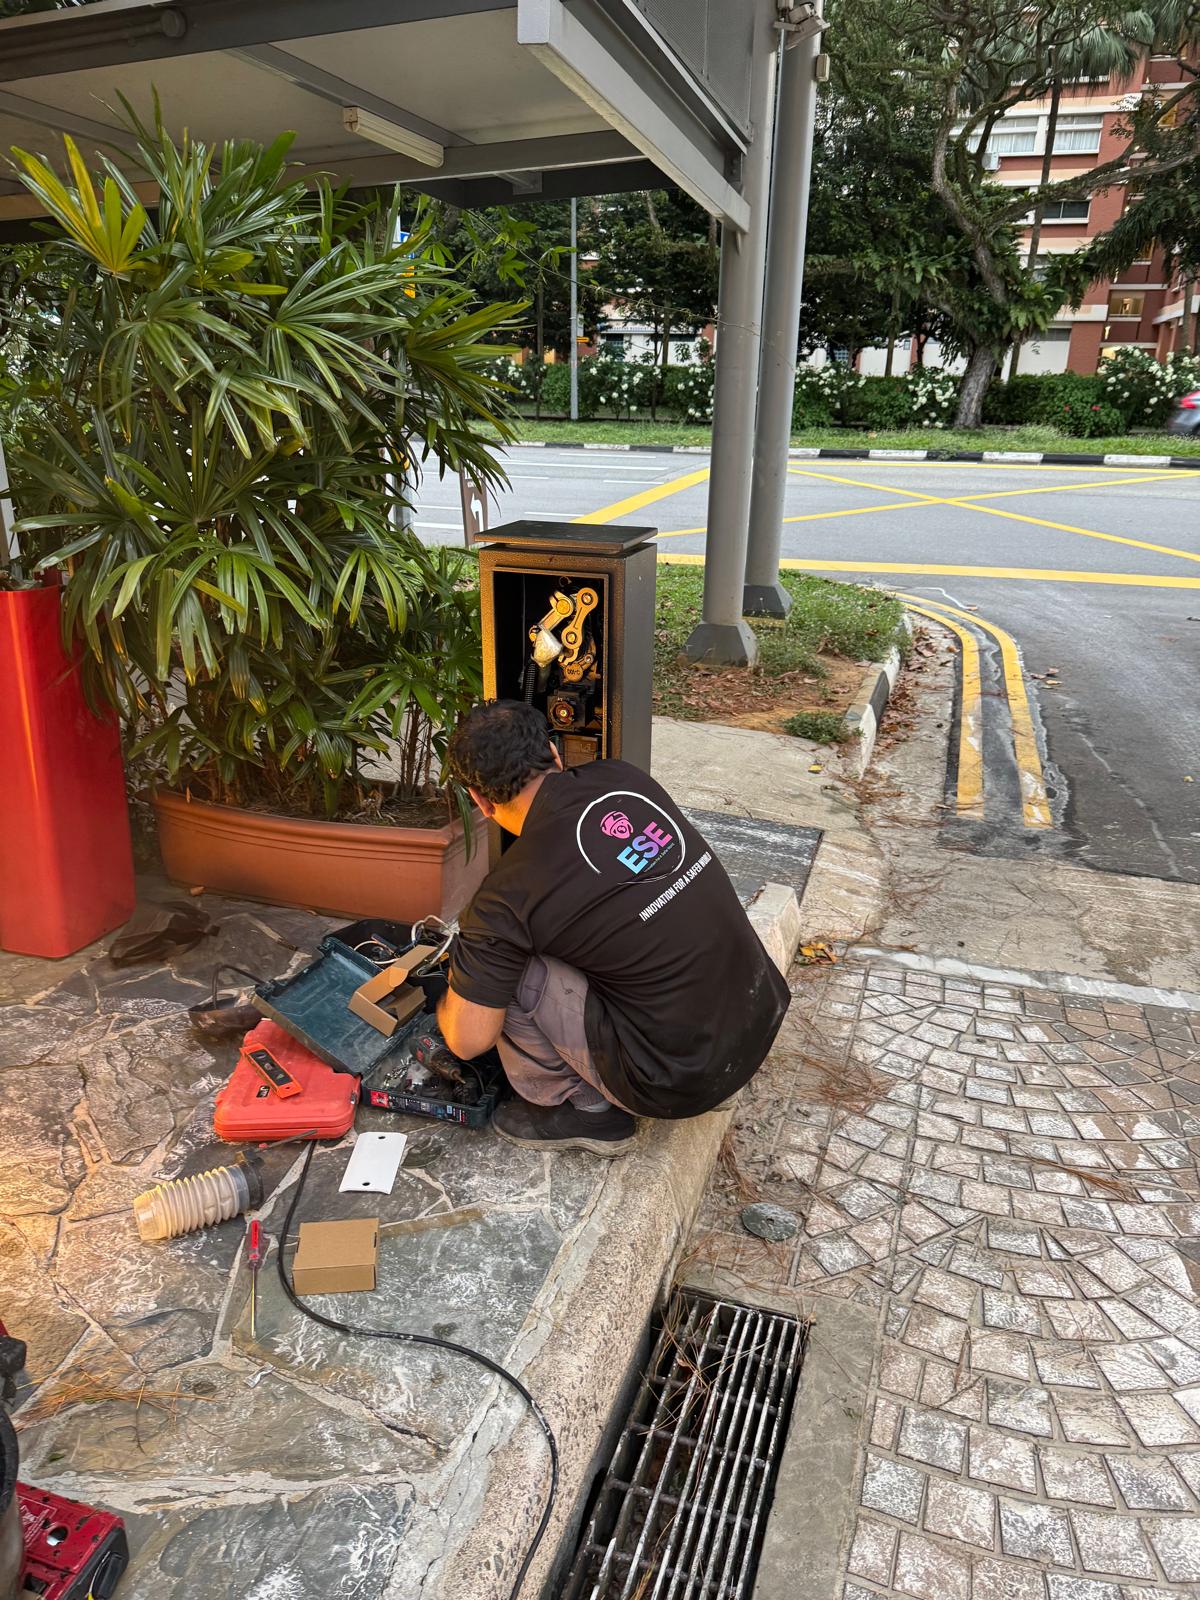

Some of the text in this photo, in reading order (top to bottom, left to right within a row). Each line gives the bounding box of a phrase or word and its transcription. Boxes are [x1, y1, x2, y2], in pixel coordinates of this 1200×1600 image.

[616, 821, 673, 875] ESE
[682, 874, 691, 884] A
[686, 862, 703, 880] SAFER
[672, 877, 687, 893] FOR
[638, 886, 677, 922] INNOVATION
